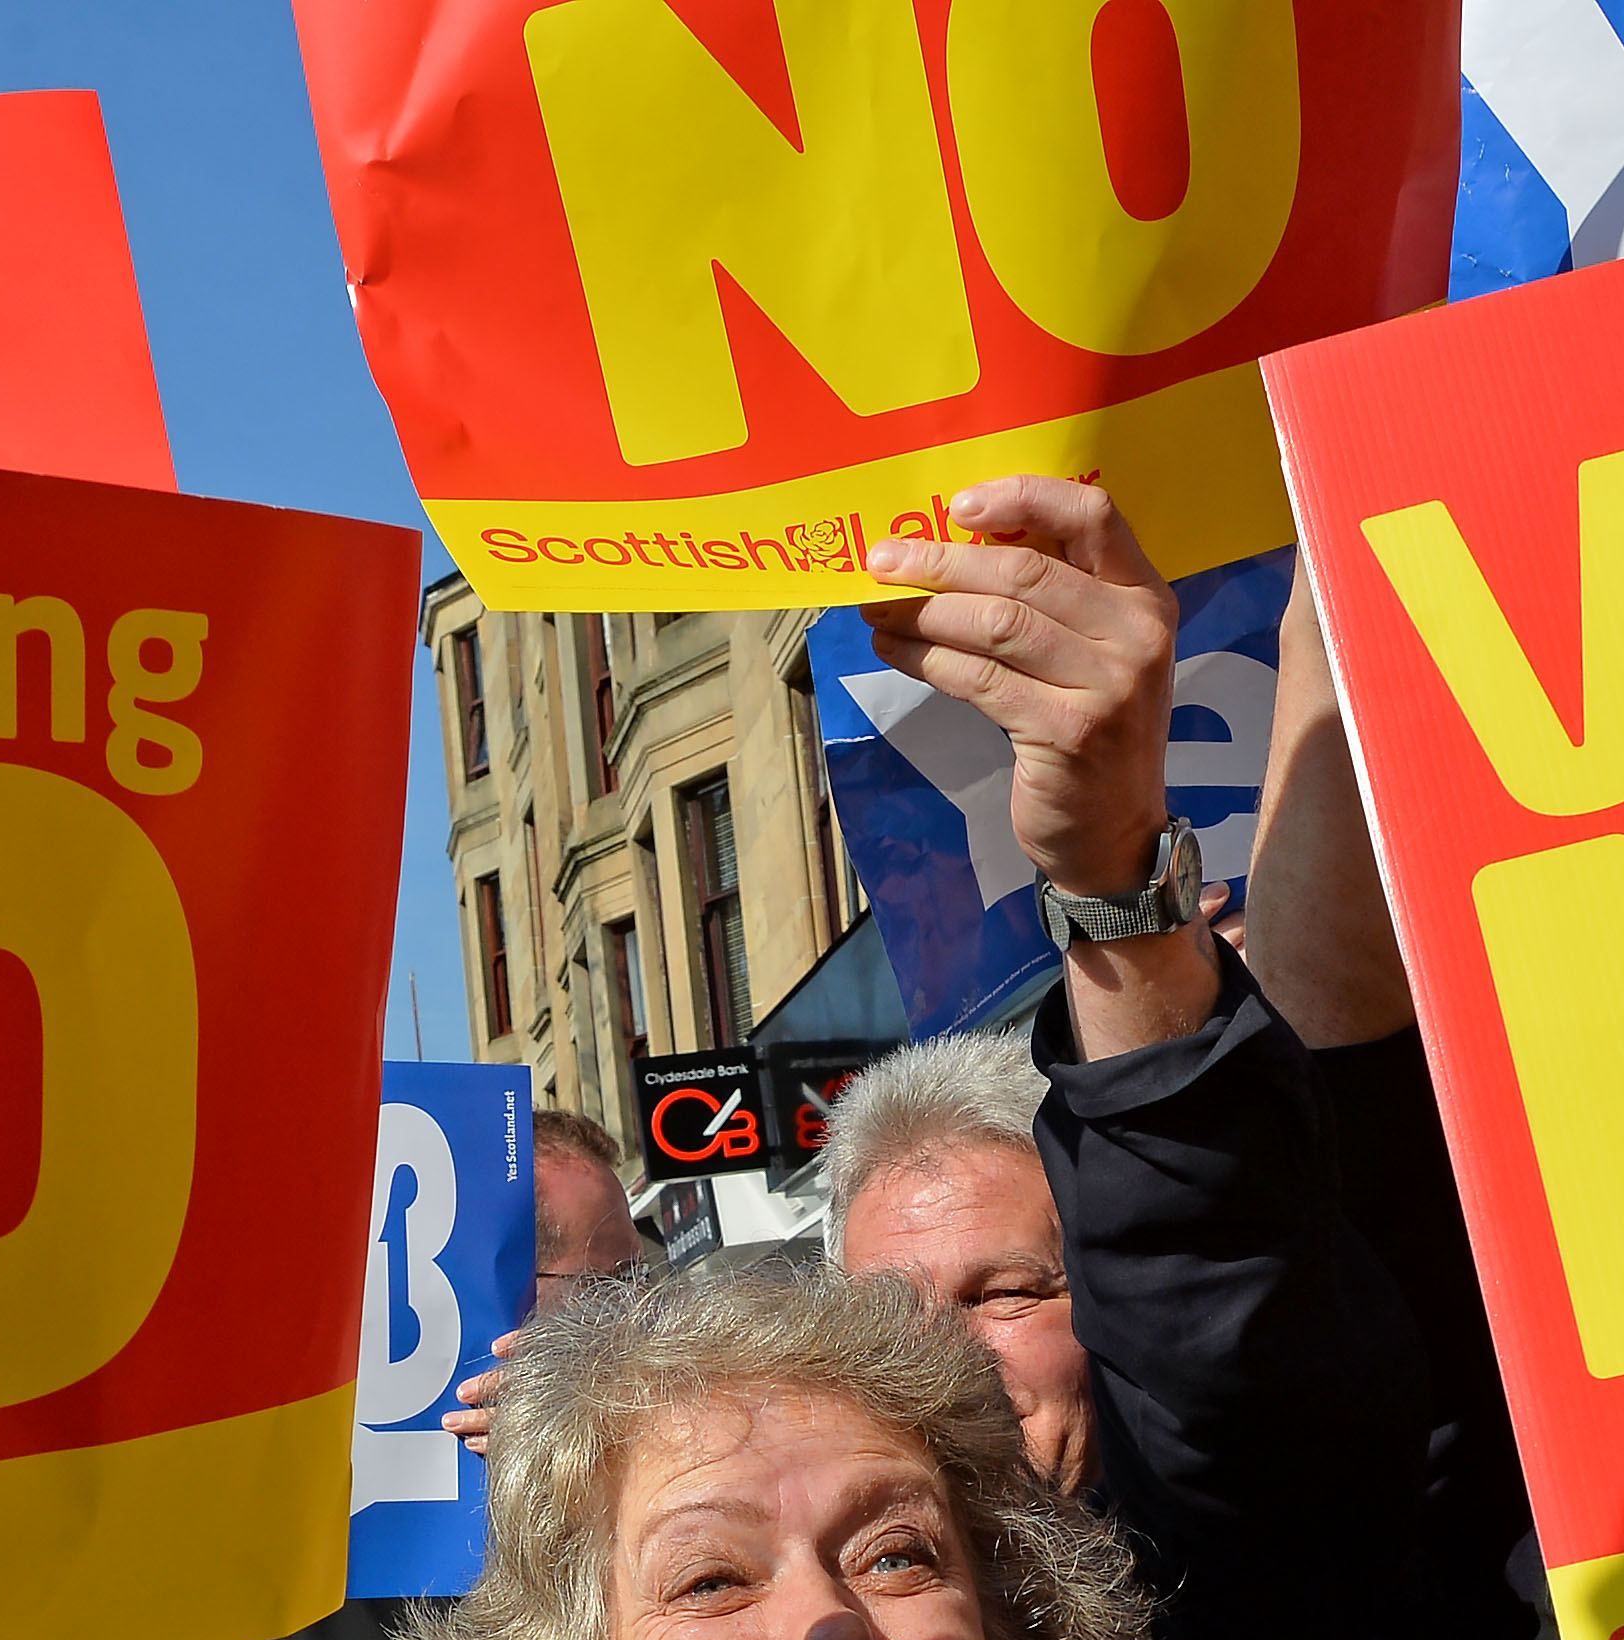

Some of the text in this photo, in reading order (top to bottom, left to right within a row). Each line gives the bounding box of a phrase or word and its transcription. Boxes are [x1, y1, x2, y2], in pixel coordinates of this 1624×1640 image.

[524, 0, 1301, 466] NO
[481, 527, 796, 573] Scottish
[644, 1062, 750, 1087] Clydesdale Bank
